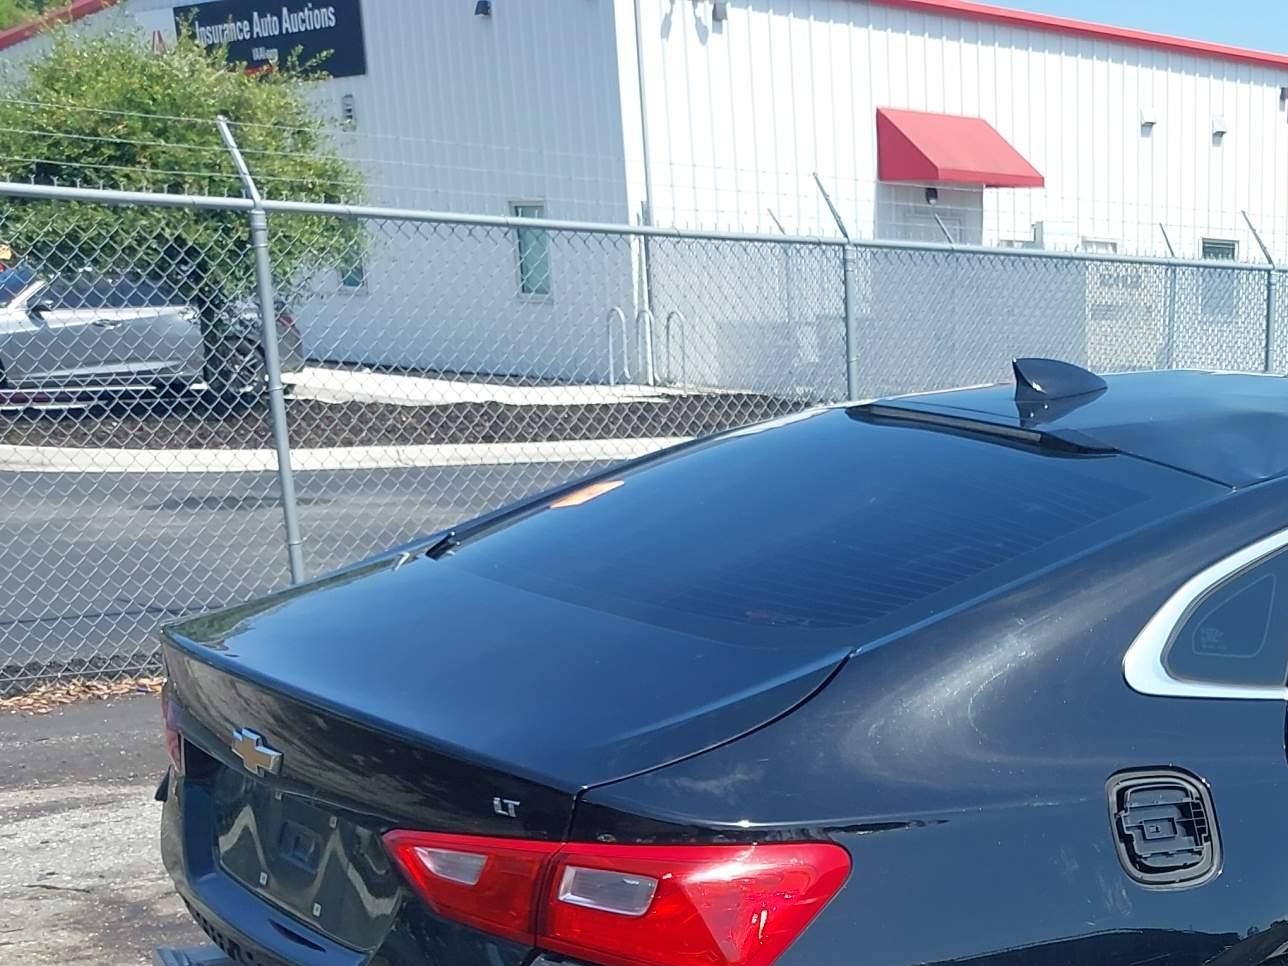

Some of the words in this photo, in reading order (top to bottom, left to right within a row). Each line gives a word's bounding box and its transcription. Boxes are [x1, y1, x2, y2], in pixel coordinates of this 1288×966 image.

[195, 20, 250, 45] Insurance
[253, 11, 279, 39] Auto
[282, 3, 336, 34] Auctions
[493, 797, 520, 817] LT
